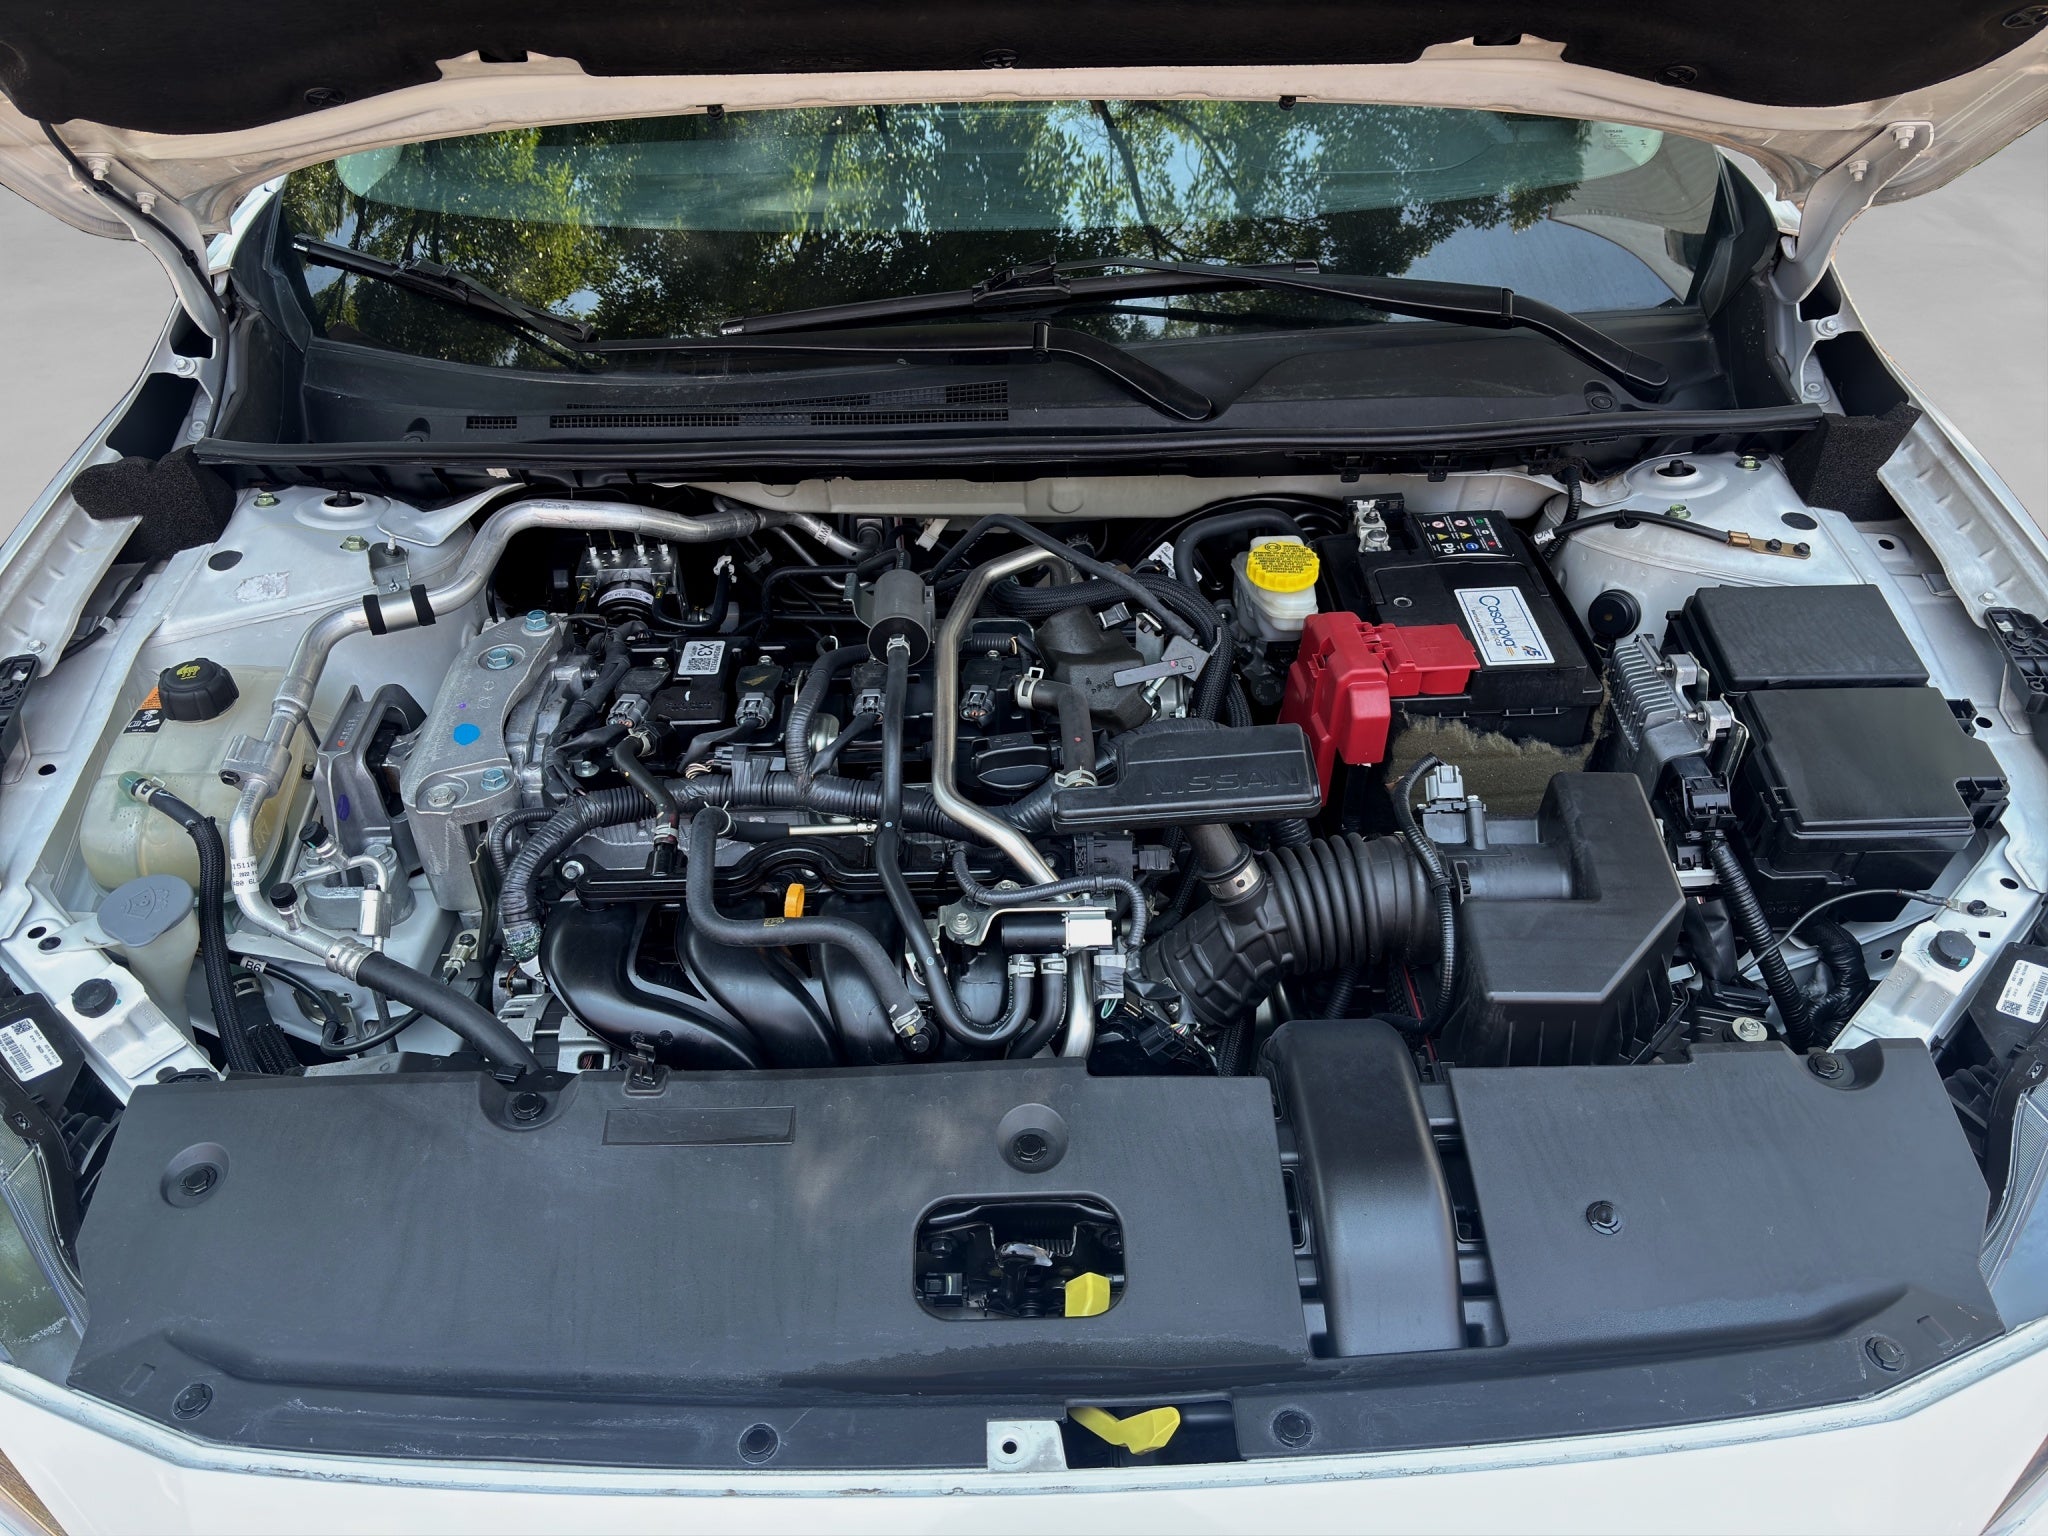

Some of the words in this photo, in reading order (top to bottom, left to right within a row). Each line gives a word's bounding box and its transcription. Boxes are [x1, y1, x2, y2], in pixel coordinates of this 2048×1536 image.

[1441, 542, 1457, 554] Pb
[1478, 595, 1516, 648] Casanova
[698, 643, 715, 657] X3
[1144, 767, 1299, 796] NISSAN
[245, 960, 262, 973] B6
